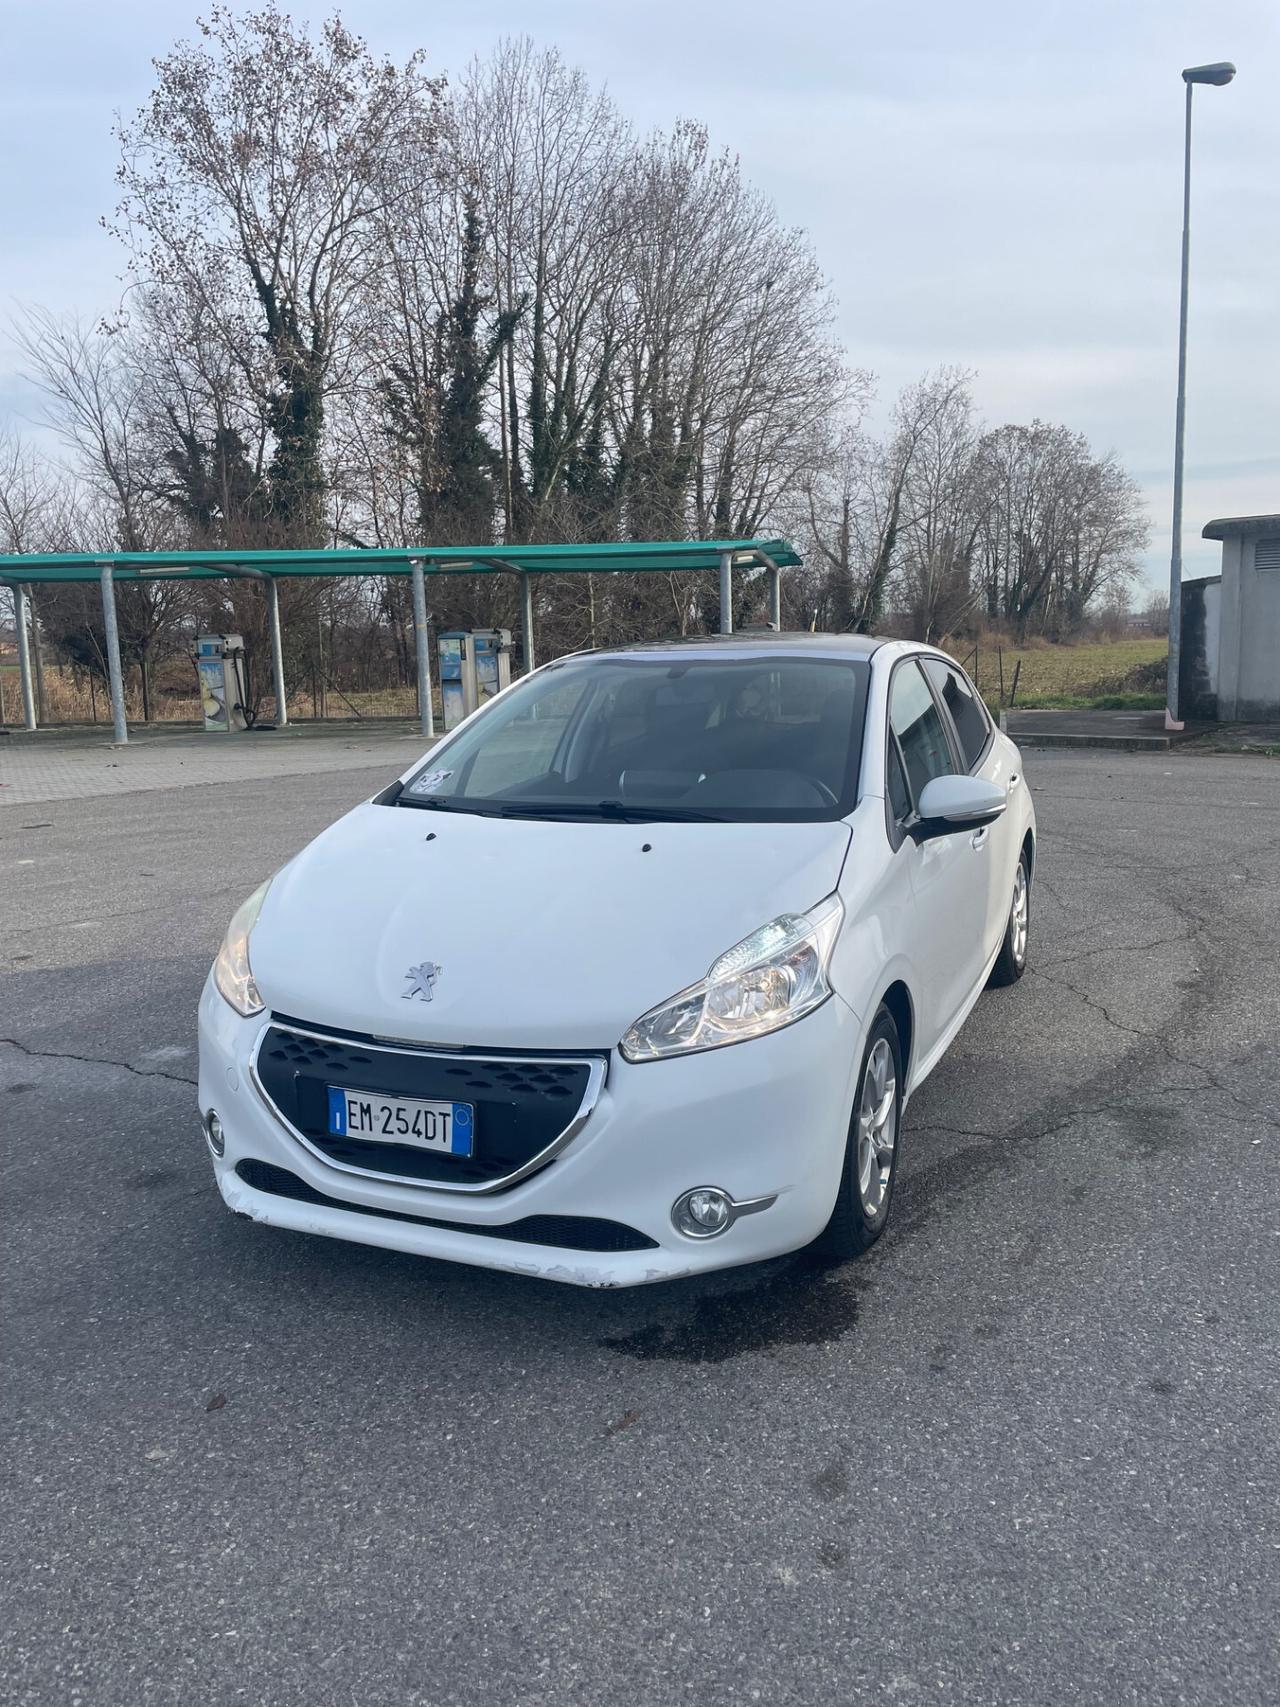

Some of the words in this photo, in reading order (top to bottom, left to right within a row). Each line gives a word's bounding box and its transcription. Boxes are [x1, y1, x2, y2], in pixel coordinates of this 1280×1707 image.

[335, 1112, 341, 1130] I
[347, 1099, 373, 1131] EM
[380, 1105, 451, 1143] 254DT
